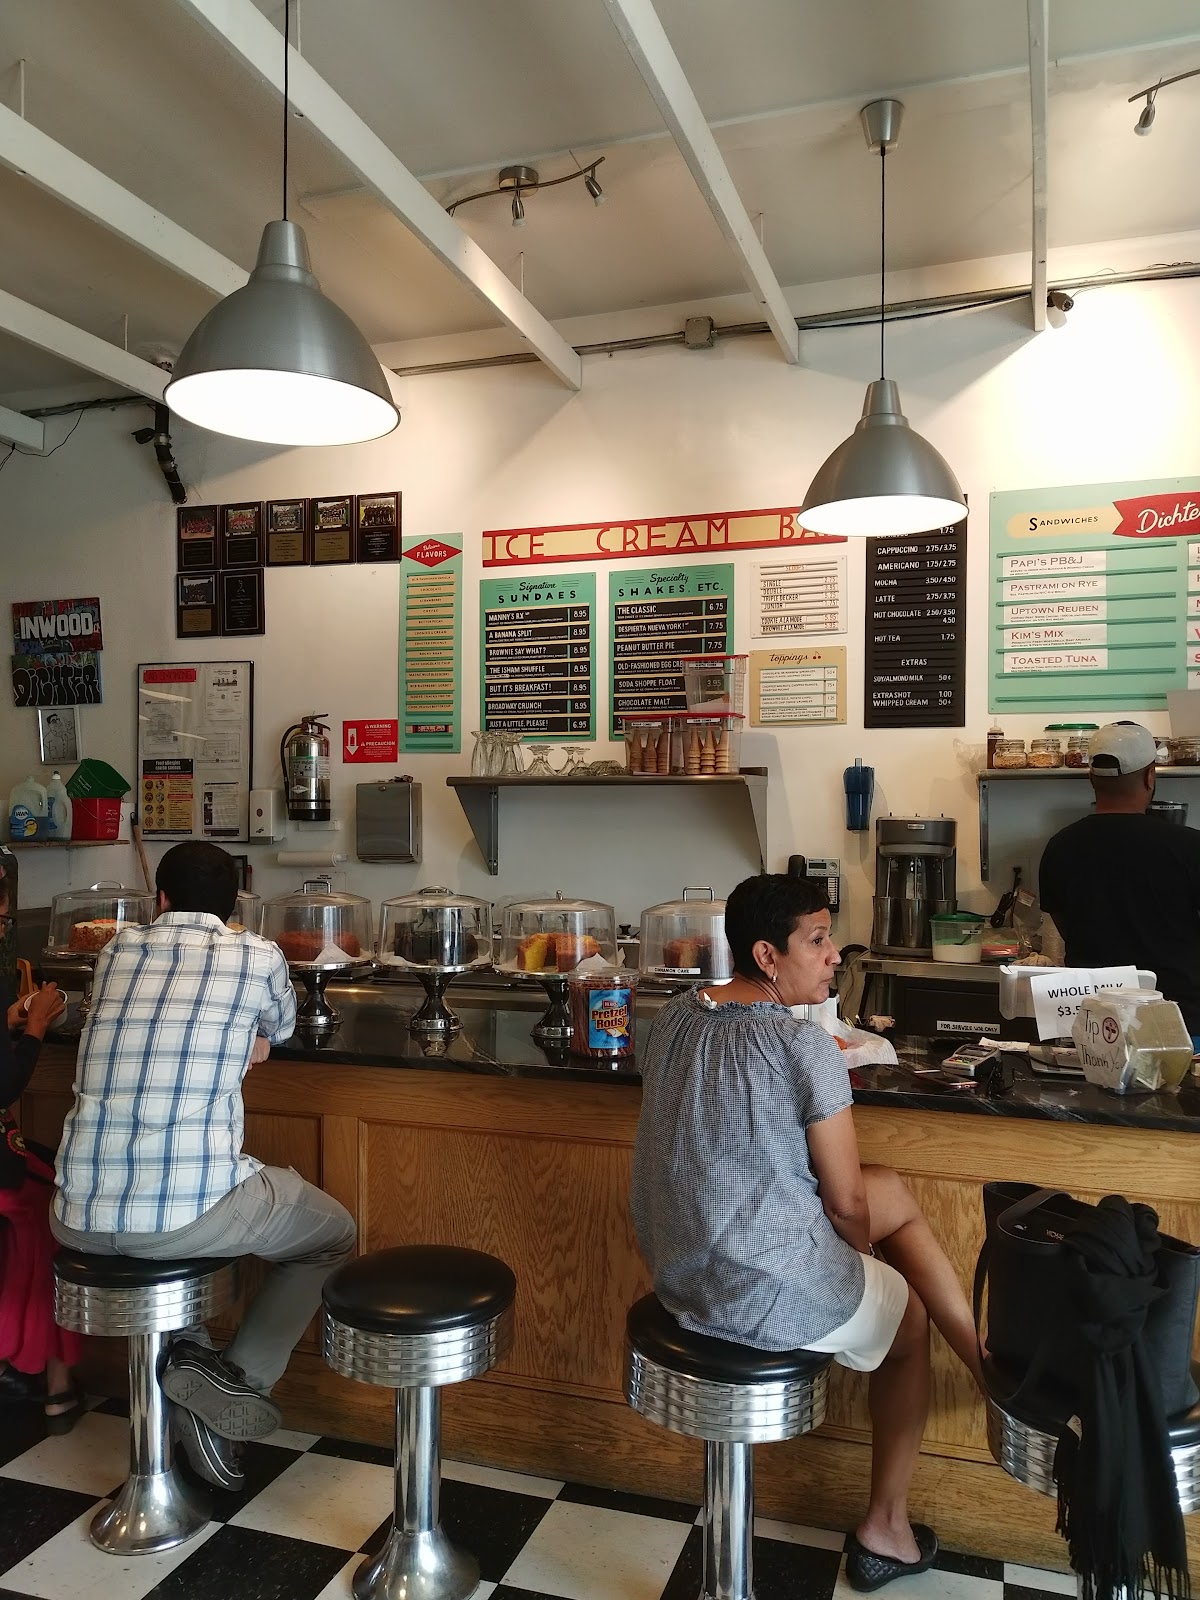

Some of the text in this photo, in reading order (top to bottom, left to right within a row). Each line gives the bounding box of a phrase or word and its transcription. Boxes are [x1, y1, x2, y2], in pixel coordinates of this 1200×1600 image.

[940, 526, 954, 534] 1.75
[491, 528, 546, 562] ICE
[595, 516, 729, 553] CREAM
[416, 550, 447, 558] FLAVORS
[877, 545, 919, 555] CAPPUCCINO
[1050, 555, 1083, 565] PB&J
[877, 561, 920, 571] AMERICANO
[650, 572, 689, 586] Specialty
[763, 580, 781, 588] SINGLE
[874, 579, 898, 587] MOCHA
[519, 581, 557, 593] Signature
[697, 582, 724, 592] ETC.
[498, 590, 576, 604] SUNDAES
[780, 593, 799, 601] DECKER
[617, 603, 724, 615] THE CLASSIC 6.75
[763, 602, 783, 610] JUNIOR
[488, 612, 515, 622] MANNY'S
[573, 610, 587, 618] 8.95
[873, 611, 886, 619] HOT
[887, 609, 921, 618] CHOCOLATE
[20, 612, 94, 640] INWOOD
[762, 617, 778, 625] COOKIE
[618, 624, 646, 633] DESPIERTA
[647, 623, 666, 632] NUEVA
[709, 622, 723, 630] 7.75
[489, 631, 494, 639] A
[494, 630, 516, 639] BANANA
[517, 629, 532, 637] SPLIT
[573, 628, 586, 636] 8.95
[489, 648, 514, 656] BROWNIE
[525, 646, 547, 655] WHAT?
[573, 646, 588, 654] 8.95
[617, 641, 723, 652] PEANUT BUTTER PIE 7.75
[769, 653, 808, 665] toppings
[901, 658, 927, 666] EXTRAS
[521, 665, 545, 673] SHUFFLE
[573, 664, 588, 673] 8.95
[661, 661, 672, 669] EGG
[618, 680, 634, 688] SODA
[634, 680, 657, 688] SHOPPE
[658, 678, 677, 686] FLOAT
[873, 675, 909, 683] SOY/ALMOND
[489, 685, 502, 693] BUT
[502, 684, 513, 692] IT'S
[514, 683, 552, 692] BREAKFAST!
[573, 683, 587, 692] 8.95
[938, 690, 953, 698] 1.00
[488, 701, 587, 710] BROADWAY CRUNCH 8.95
[618, 697, 671, 707] CHOCOLATE MALT
[872, 699, 904, 707] WHIPPED
[489, 720, 502, 728] JUST
[502, 720, 507, 728] A
[525, 719, 548, 727] PLEASE!
[1048, 985, 1091, 999] WHOLE
[591, 1004, 627, 1020] Pretzel
[1057, 1005, 1081, 1018] $3.5
[596, 1017, 625, 1029] Rods
[1082, 1008, 1099, 1044] Tip
[1080, 1043, 1109, 1067] Thank
